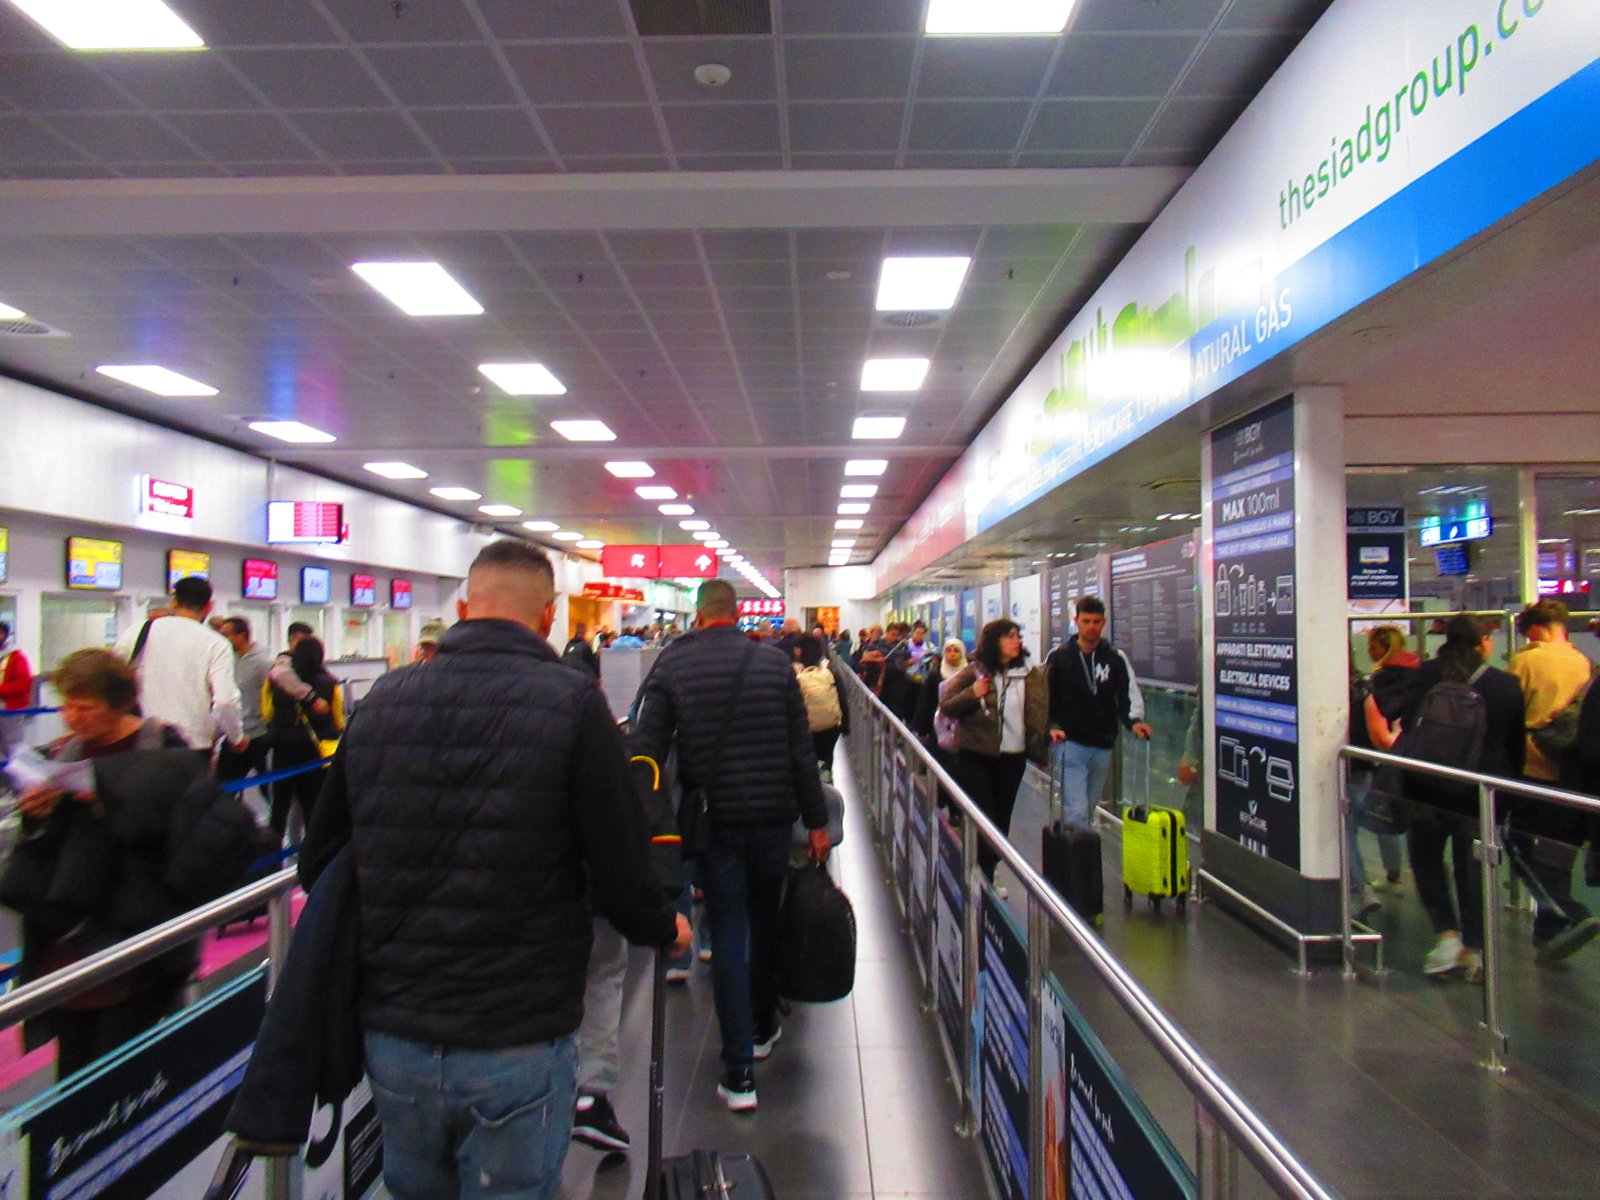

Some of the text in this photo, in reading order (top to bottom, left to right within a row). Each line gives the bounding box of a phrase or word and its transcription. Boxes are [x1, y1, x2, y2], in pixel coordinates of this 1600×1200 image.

[1255, 288, 1293, 343] GAS
[1222, 486, 1280, 522] MAX 100ml
[1367, 510, 1399, 524] BGY
[1216, 643, 1294, 659] APPARATI ELETTRONICI
[1220, 669, 1291, 691] ELECTRICAL DEVICES
